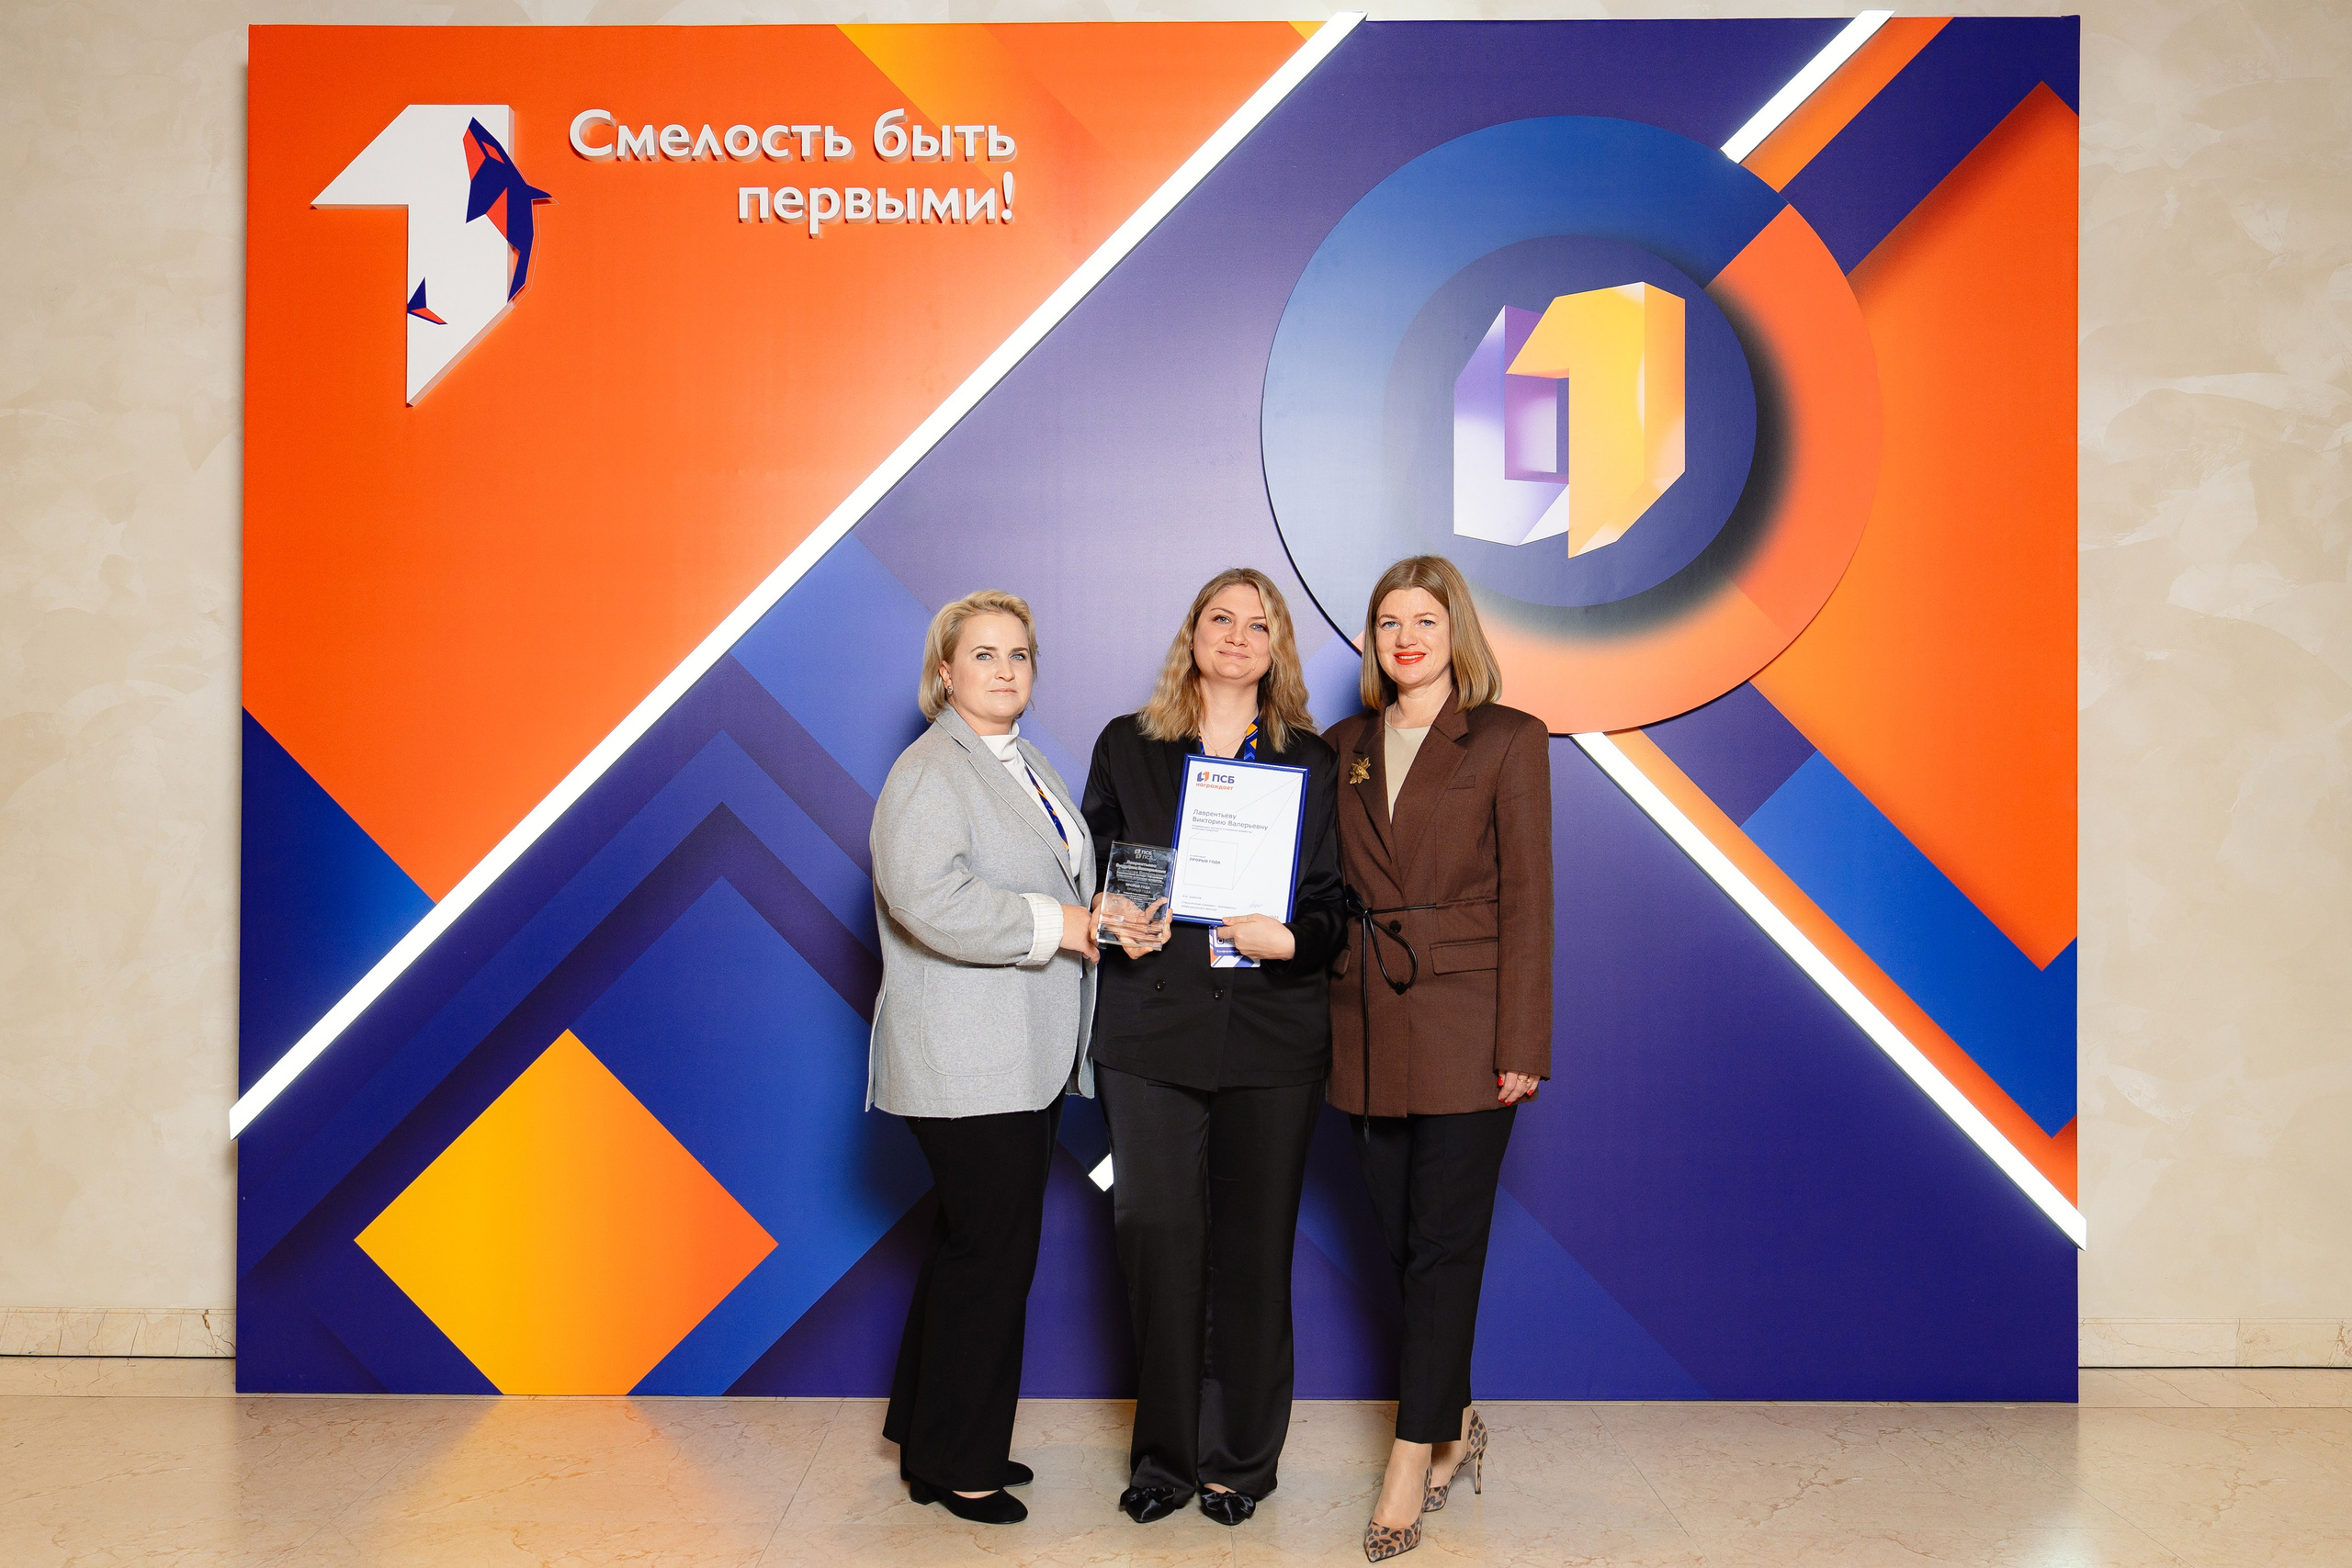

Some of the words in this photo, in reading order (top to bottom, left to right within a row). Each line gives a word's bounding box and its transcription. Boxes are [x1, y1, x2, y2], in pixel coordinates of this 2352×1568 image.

[569, 108, 855, 163] Смелость
[873, 107, 1017, 163] быть
[738, 171, 1015, 239] первыми!
[1212, 774, 1235, 784] ПСБ
[1196, 782, 1234, 790] награждает
[1193, 809, 1236, 820] Лаврентьеву
[1192, 816, 1226, 825] Викторию
[1228, 821, 1269, 831] Валерьевну
